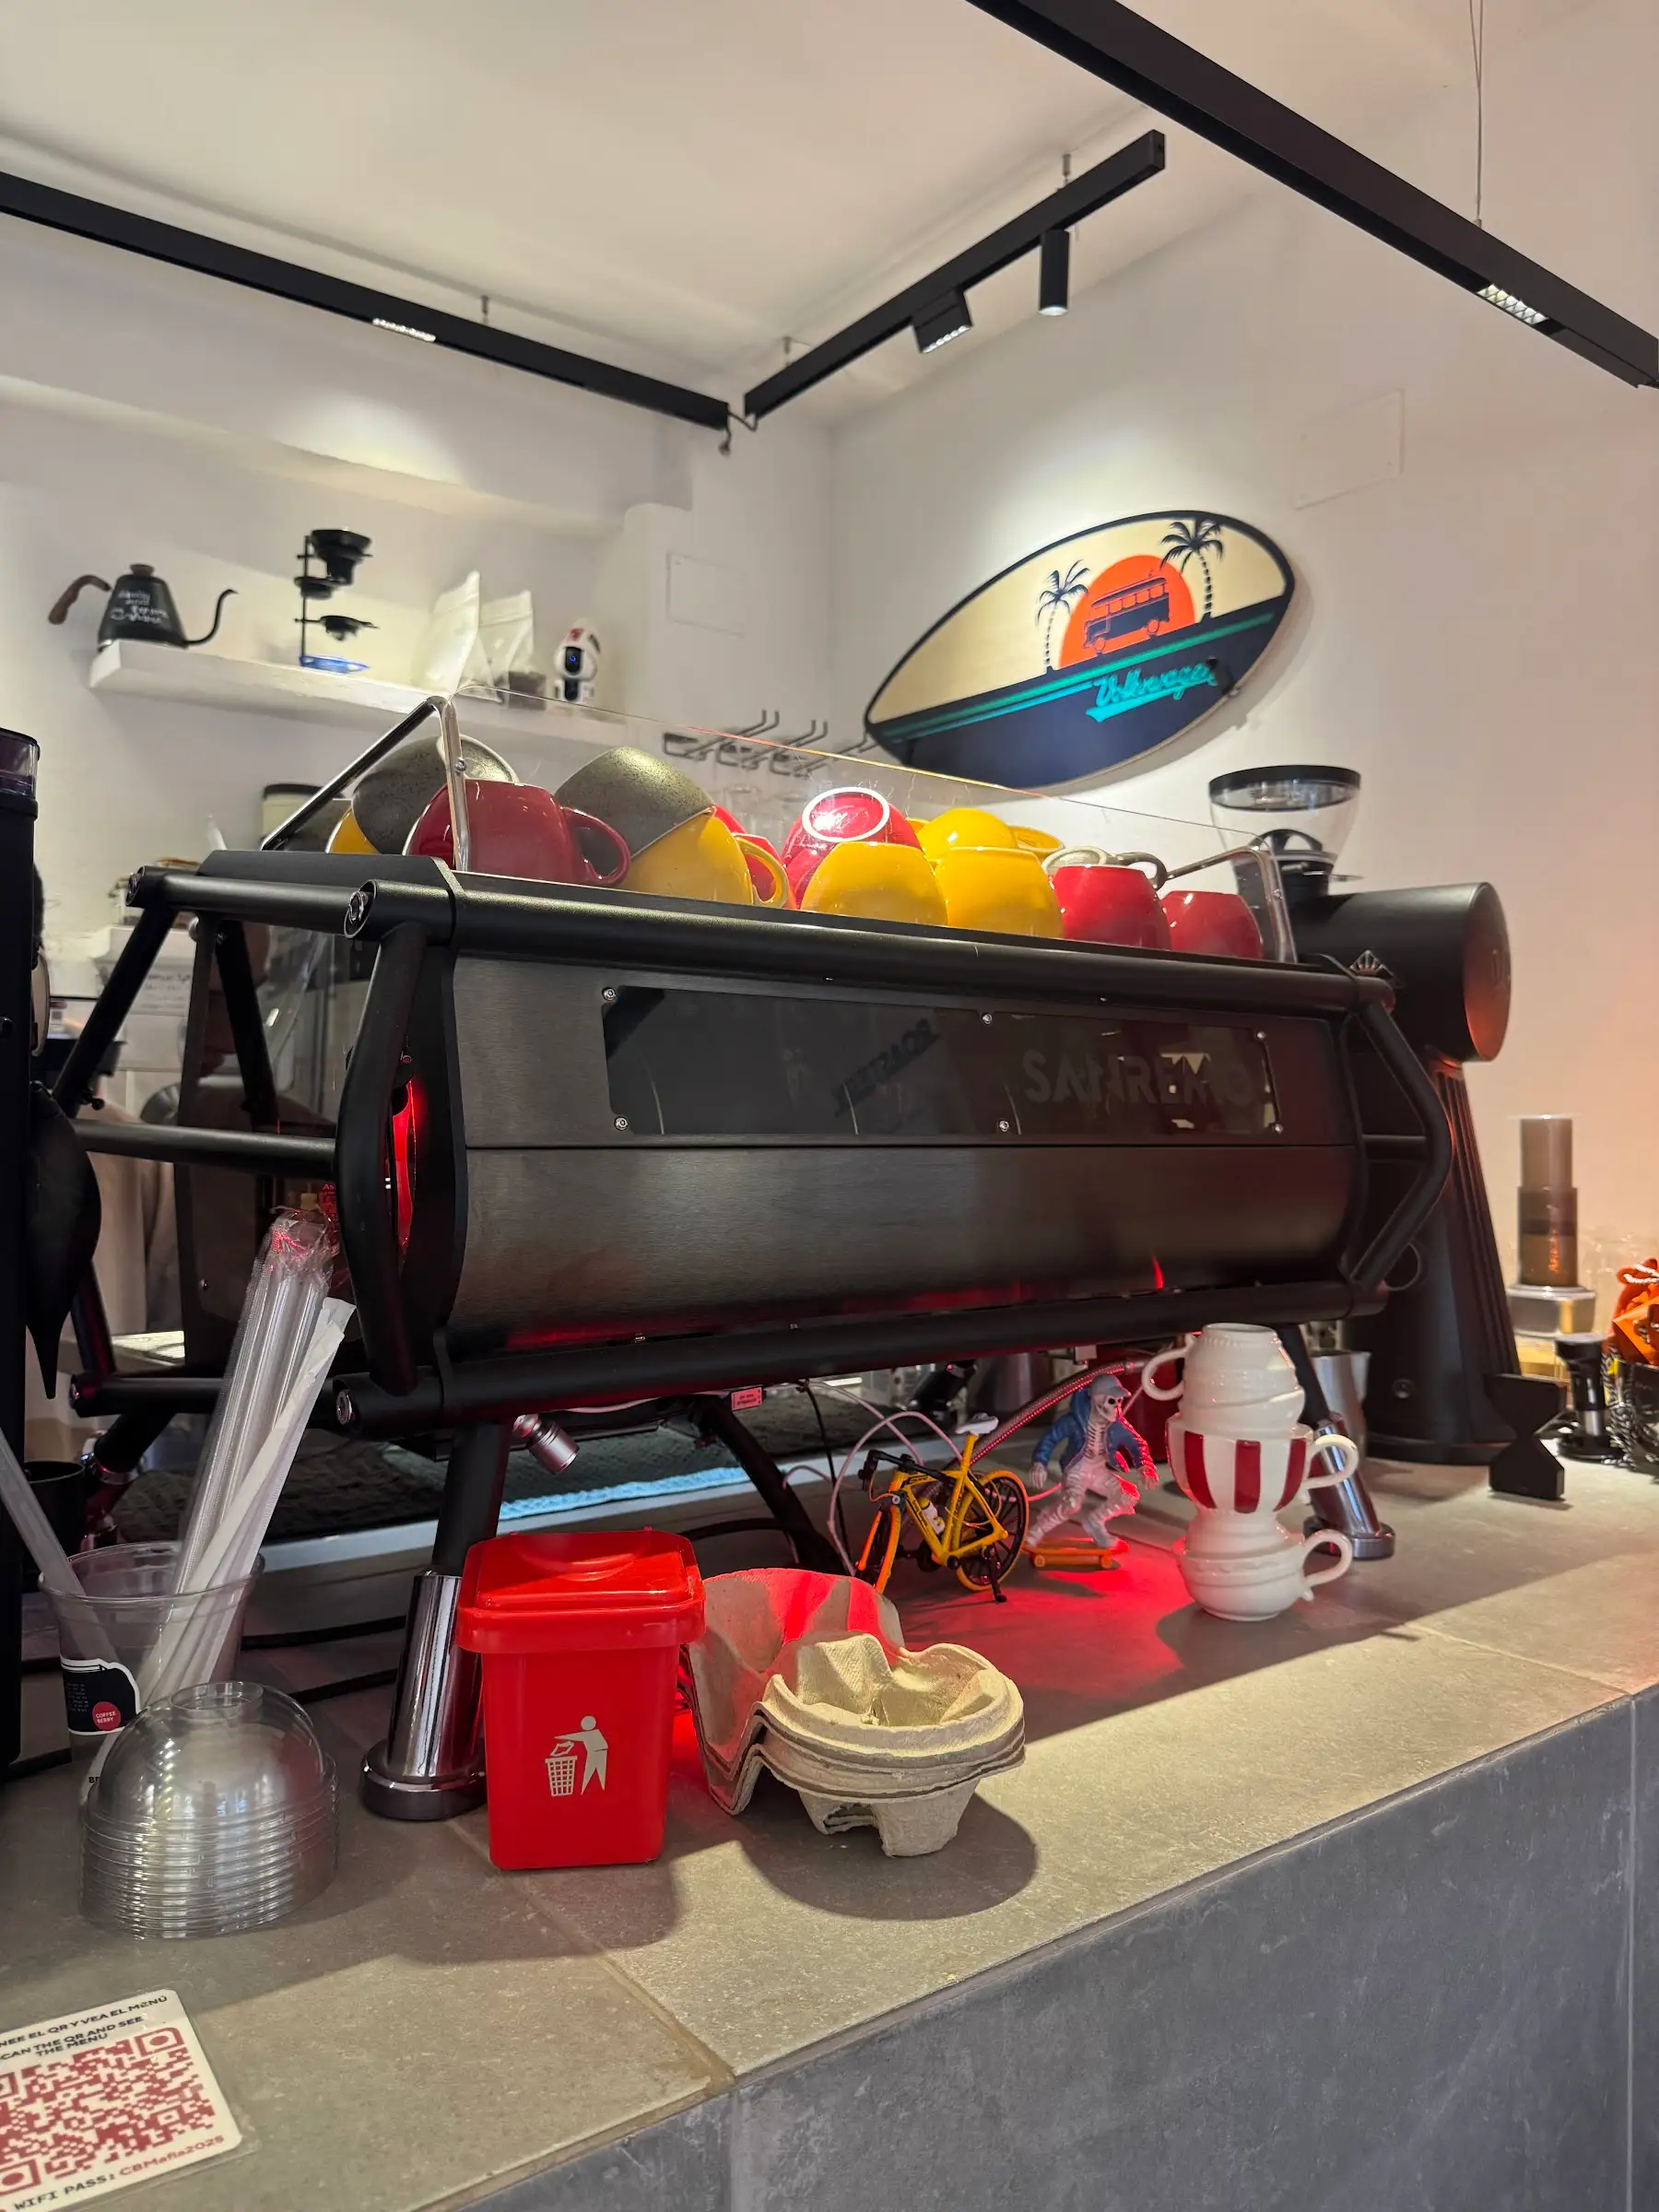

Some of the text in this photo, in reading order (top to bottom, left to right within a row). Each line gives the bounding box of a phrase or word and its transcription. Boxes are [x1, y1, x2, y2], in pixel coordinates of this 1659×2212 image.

[1022, 1048, 1256, 1107] SANREMO
[96, 1711, 117, 1719] COFFEE
[29, 2030, 45, 2039] EL
[48, 2024, 68, 2033] QR
[79, 2014, 109, 2025] VEA
[110, 2008, 128, 2017] EL
[128, 1995, 168, 2011] MENÚ
[33, 2039, 62, 2051] THE
[64, 2031, 84, 2042] QR
[85, 2024, 116, 2037] AND
[119, 2016, 144, 2027] SEE
[35, 2033, 108, 2057] THE MENU
[14, 2189, 58, 2211] WIFI
[64, 2173, 116, 2195] PASS:
